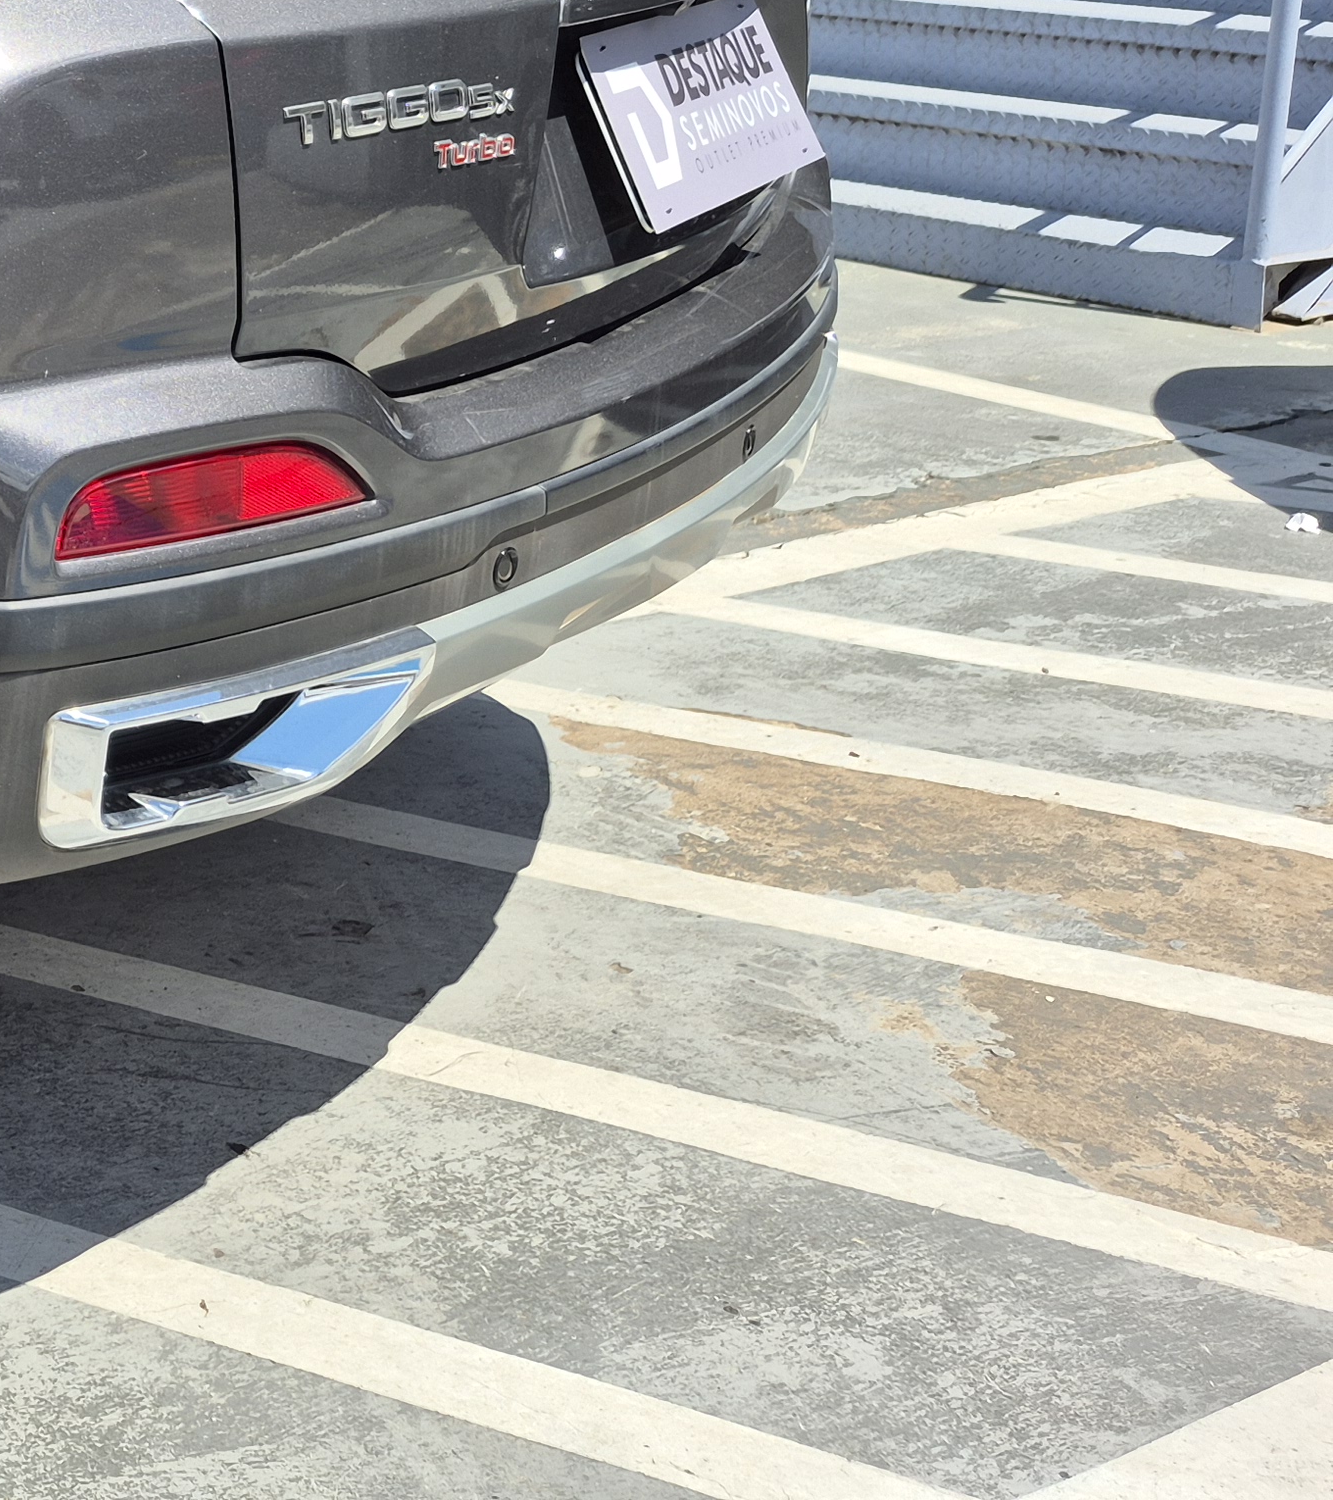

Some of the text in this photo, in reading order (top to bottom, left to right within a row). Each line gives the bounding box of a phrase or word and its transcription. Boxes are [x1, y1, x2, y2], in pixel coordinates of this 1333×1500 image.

[654, 25, 773, 107] DESTAQUE
[679, 81, 791, 150] SEMINOVOS
[434, 132, 515, 169] Turbo
[695, 120, 801, 174] OUTLET PREMIUM
